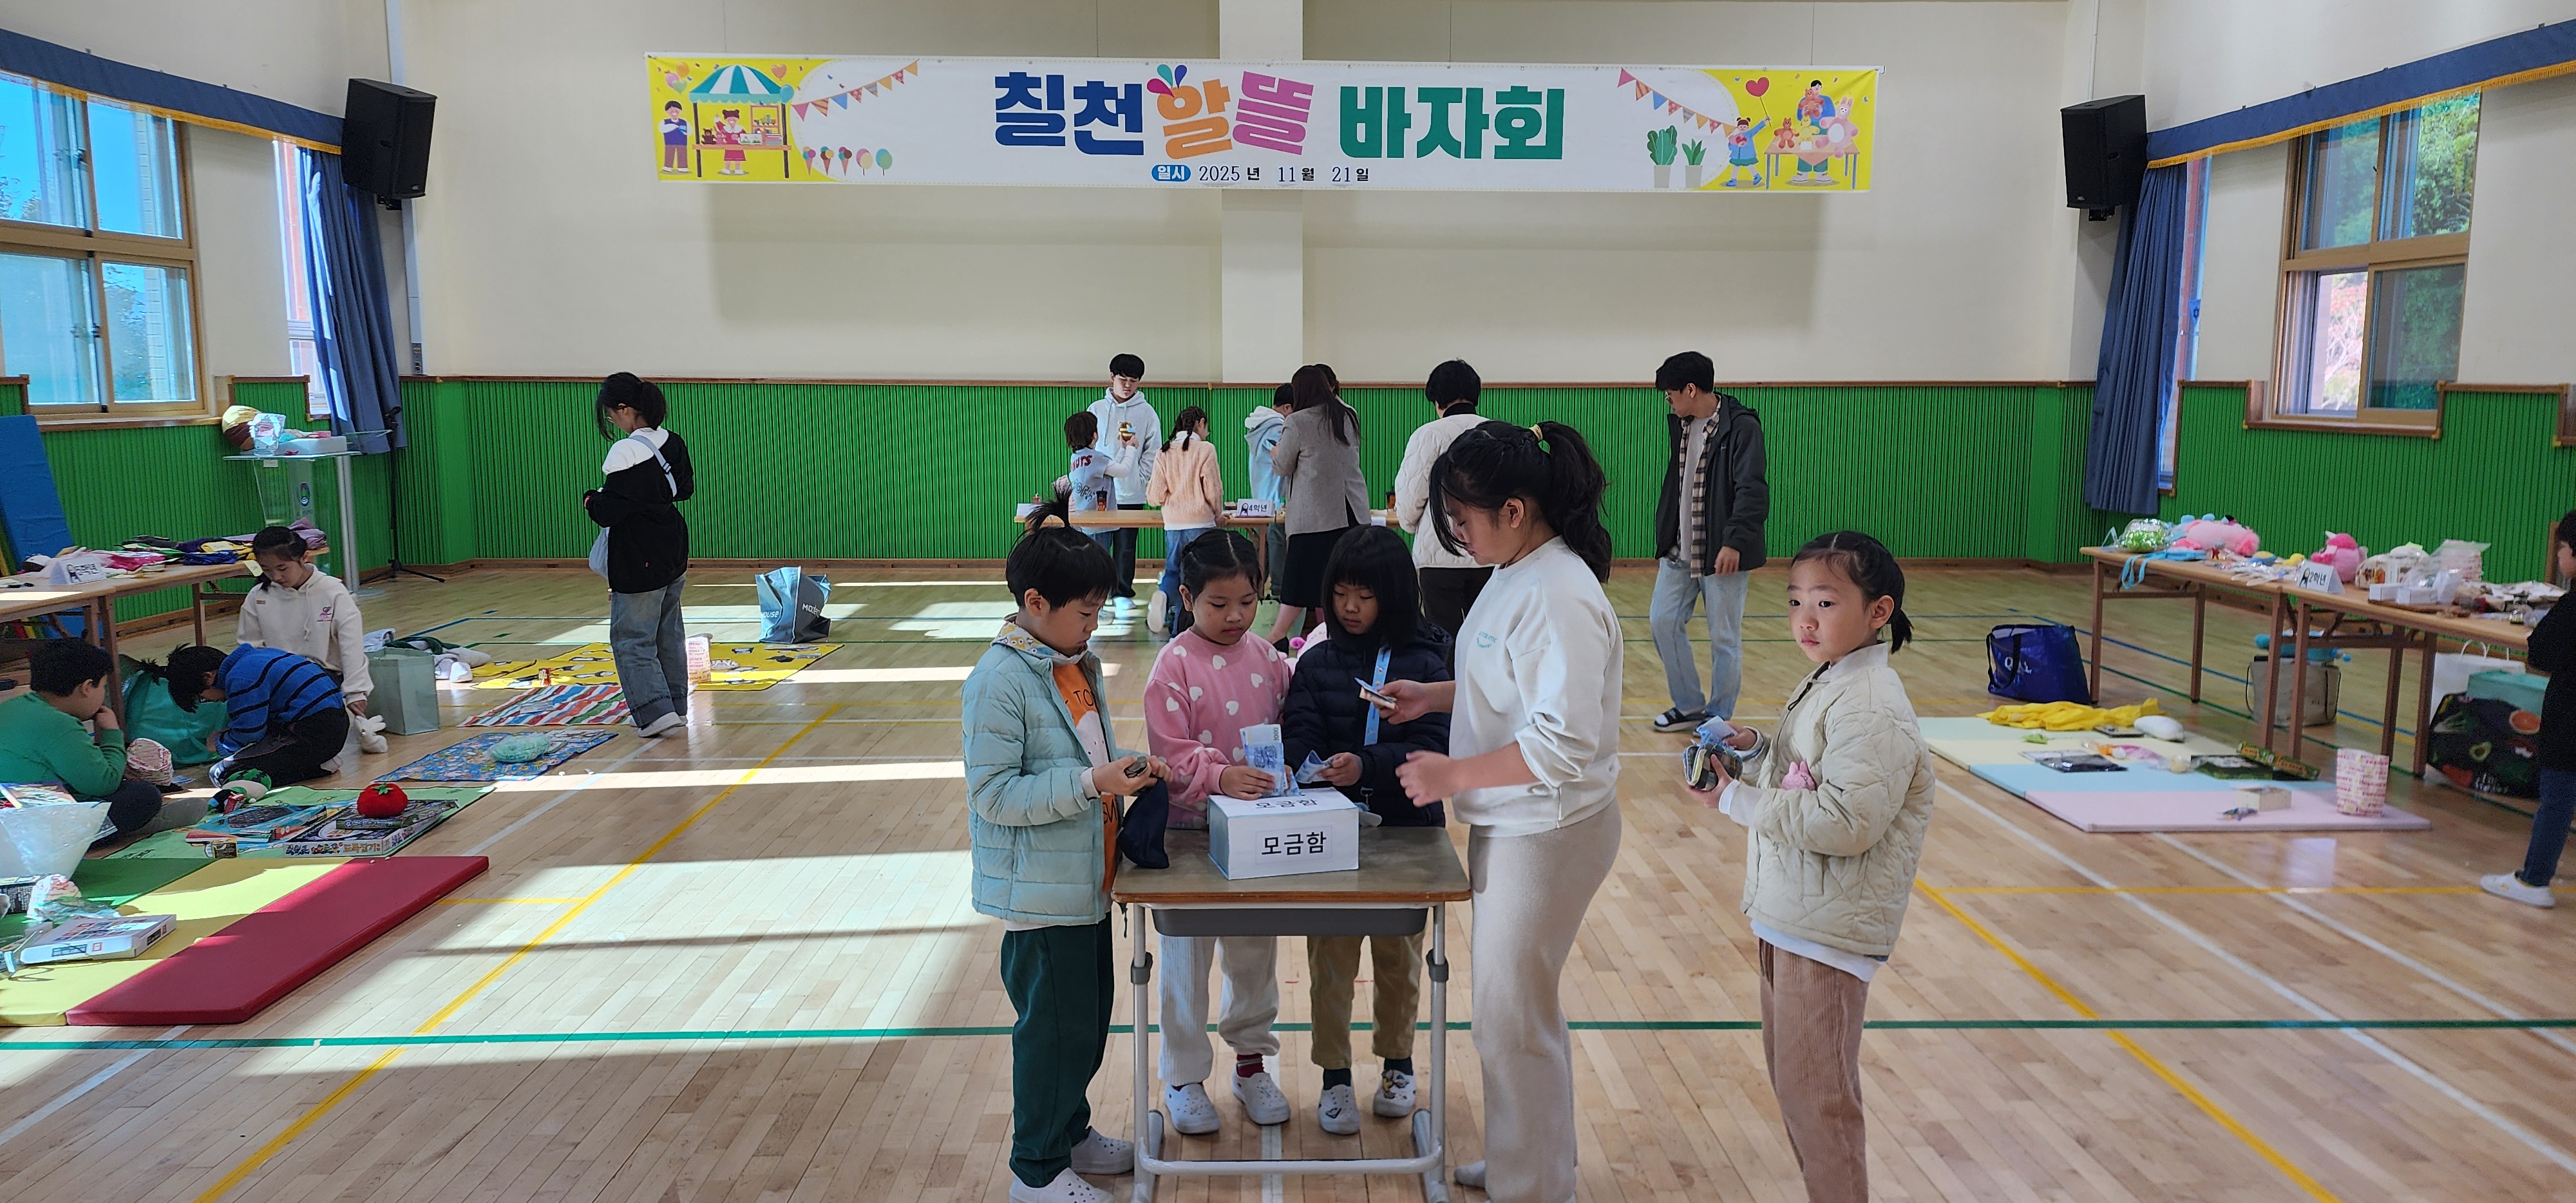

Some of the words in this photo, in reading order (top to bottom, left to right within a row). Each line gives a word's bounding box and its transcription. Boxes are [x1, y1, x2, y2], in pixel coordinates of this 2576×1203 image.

[994, 71, 1144, 156] 칠천
[1156, 70, 1314, 160] 알뜰
[1340, 86, 1565, 160] 바자회
[1157, 166, 1186, 181] 일시
[1198, 166, 1240, 182] 2025
[1255, 799, 1318, 809] 모금함
[1261, 831, 1327, 855] 모금함
